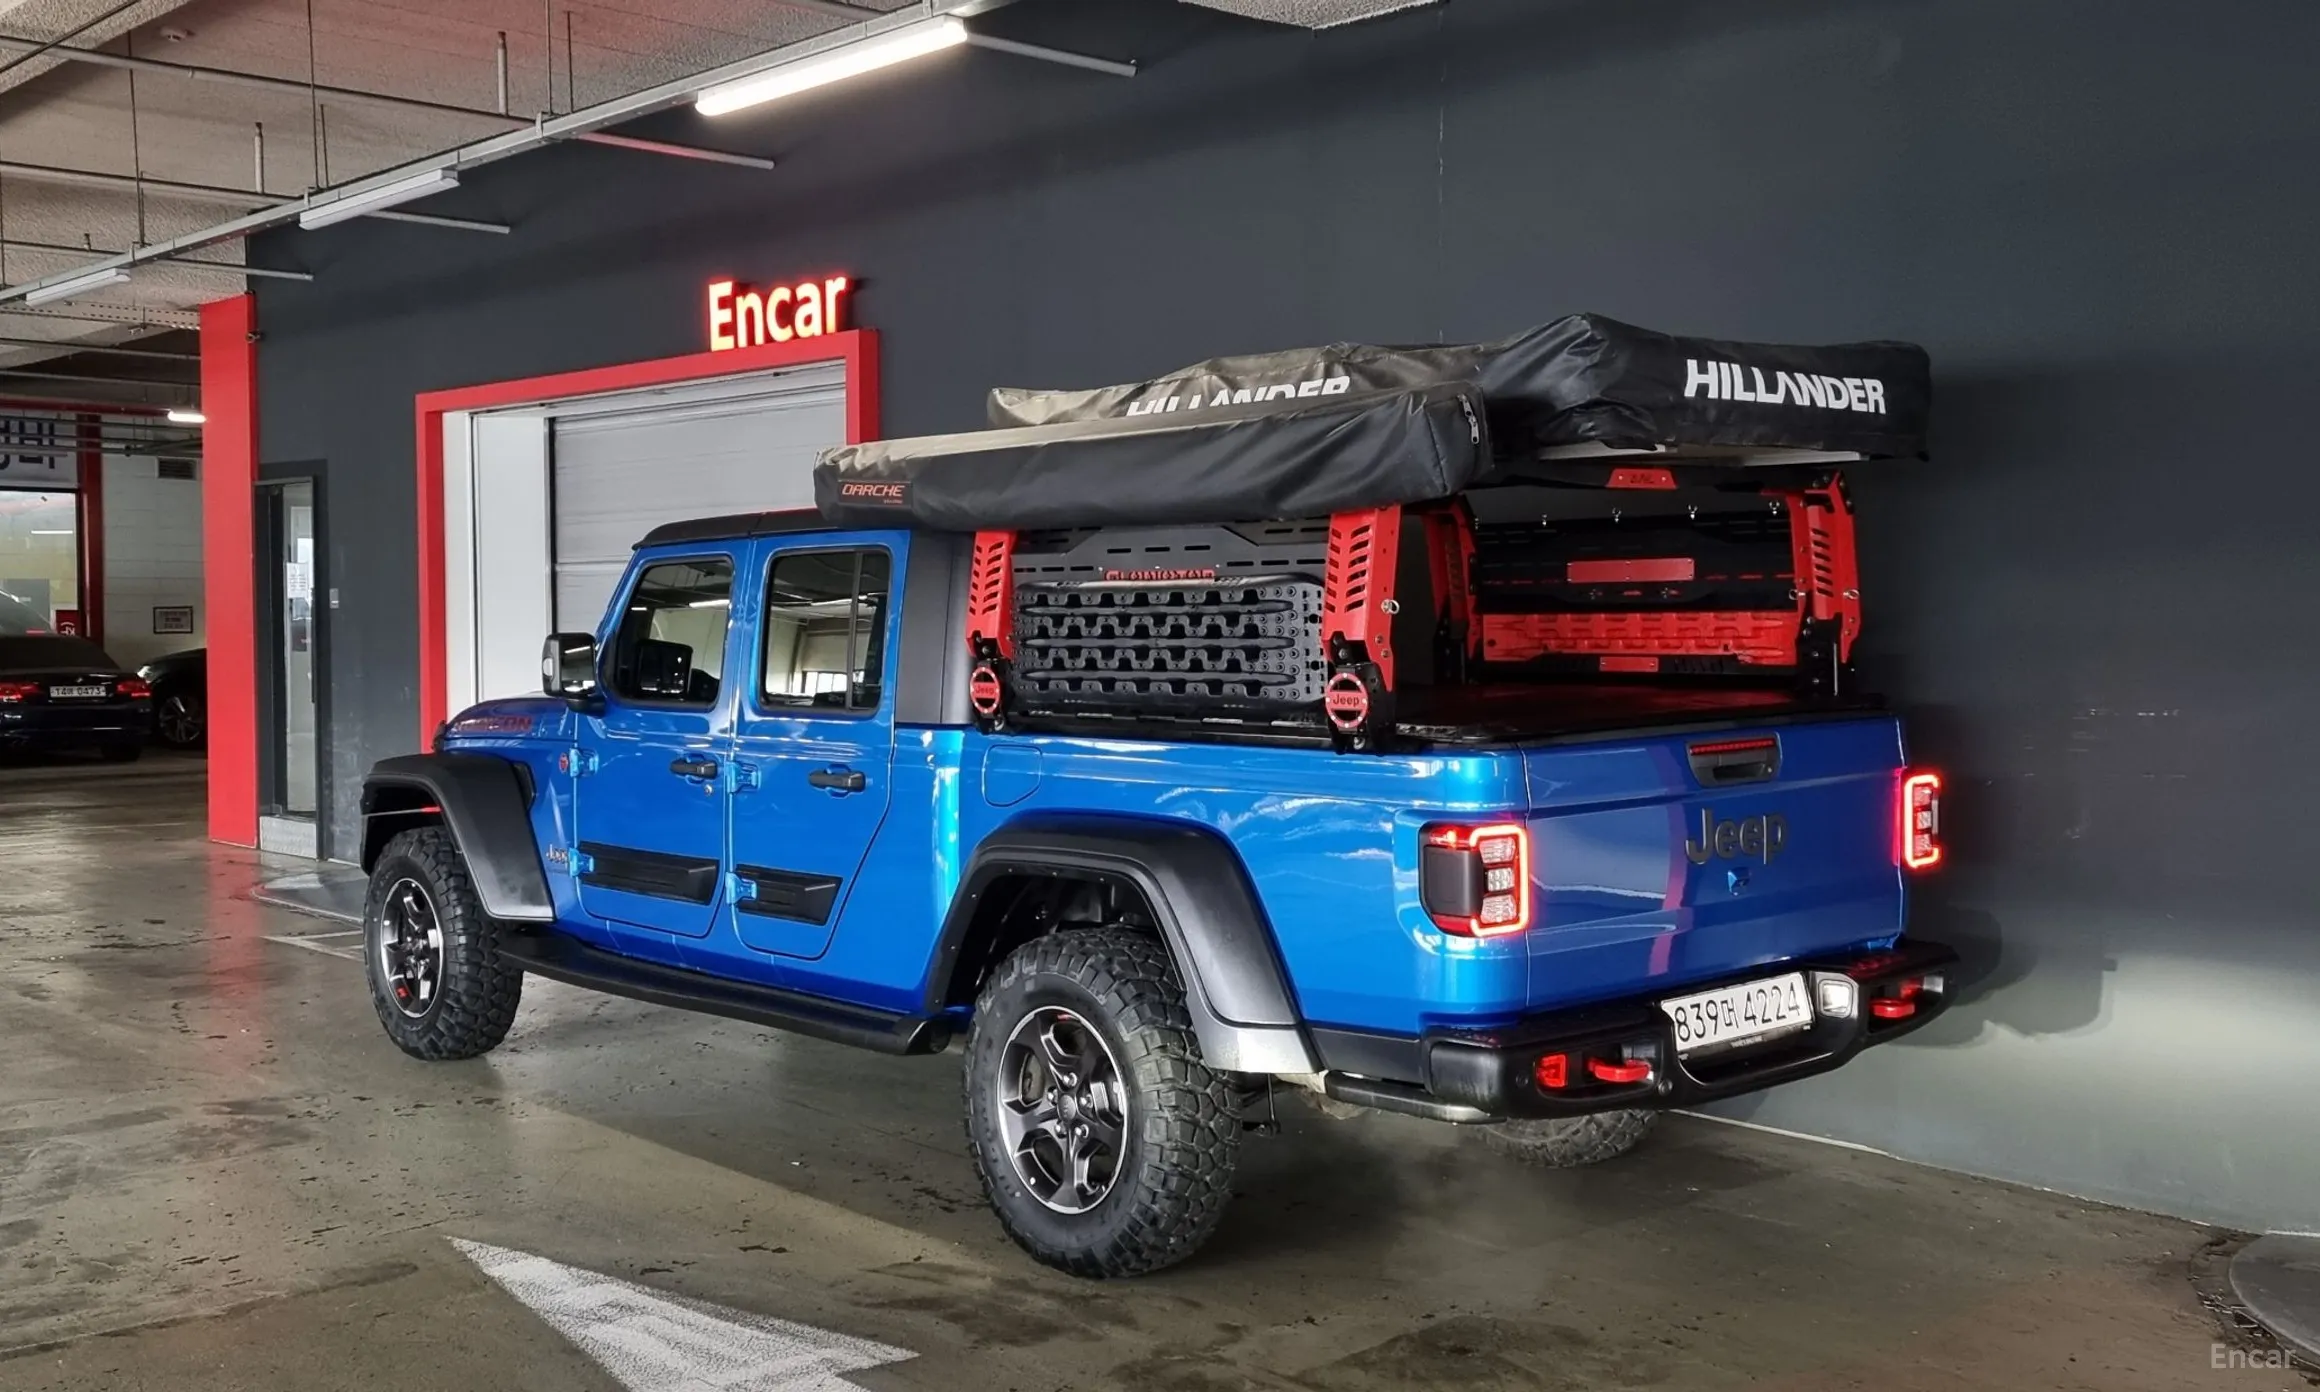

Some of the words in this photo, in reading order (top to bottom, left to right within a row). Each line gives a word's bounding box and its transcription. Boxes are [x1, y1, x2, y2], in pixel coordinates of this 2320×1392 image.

[709, 276, 847, 352] Encar
[1684, 358, 1887, 415] HILLANDER
[1332, 694, 1360, 708] Jeep
[1685, 808, 1787, 865] Jeep
[1674, 997, 1740, 1042] 839머
[1744, 981, 1800, 1027] 4224
